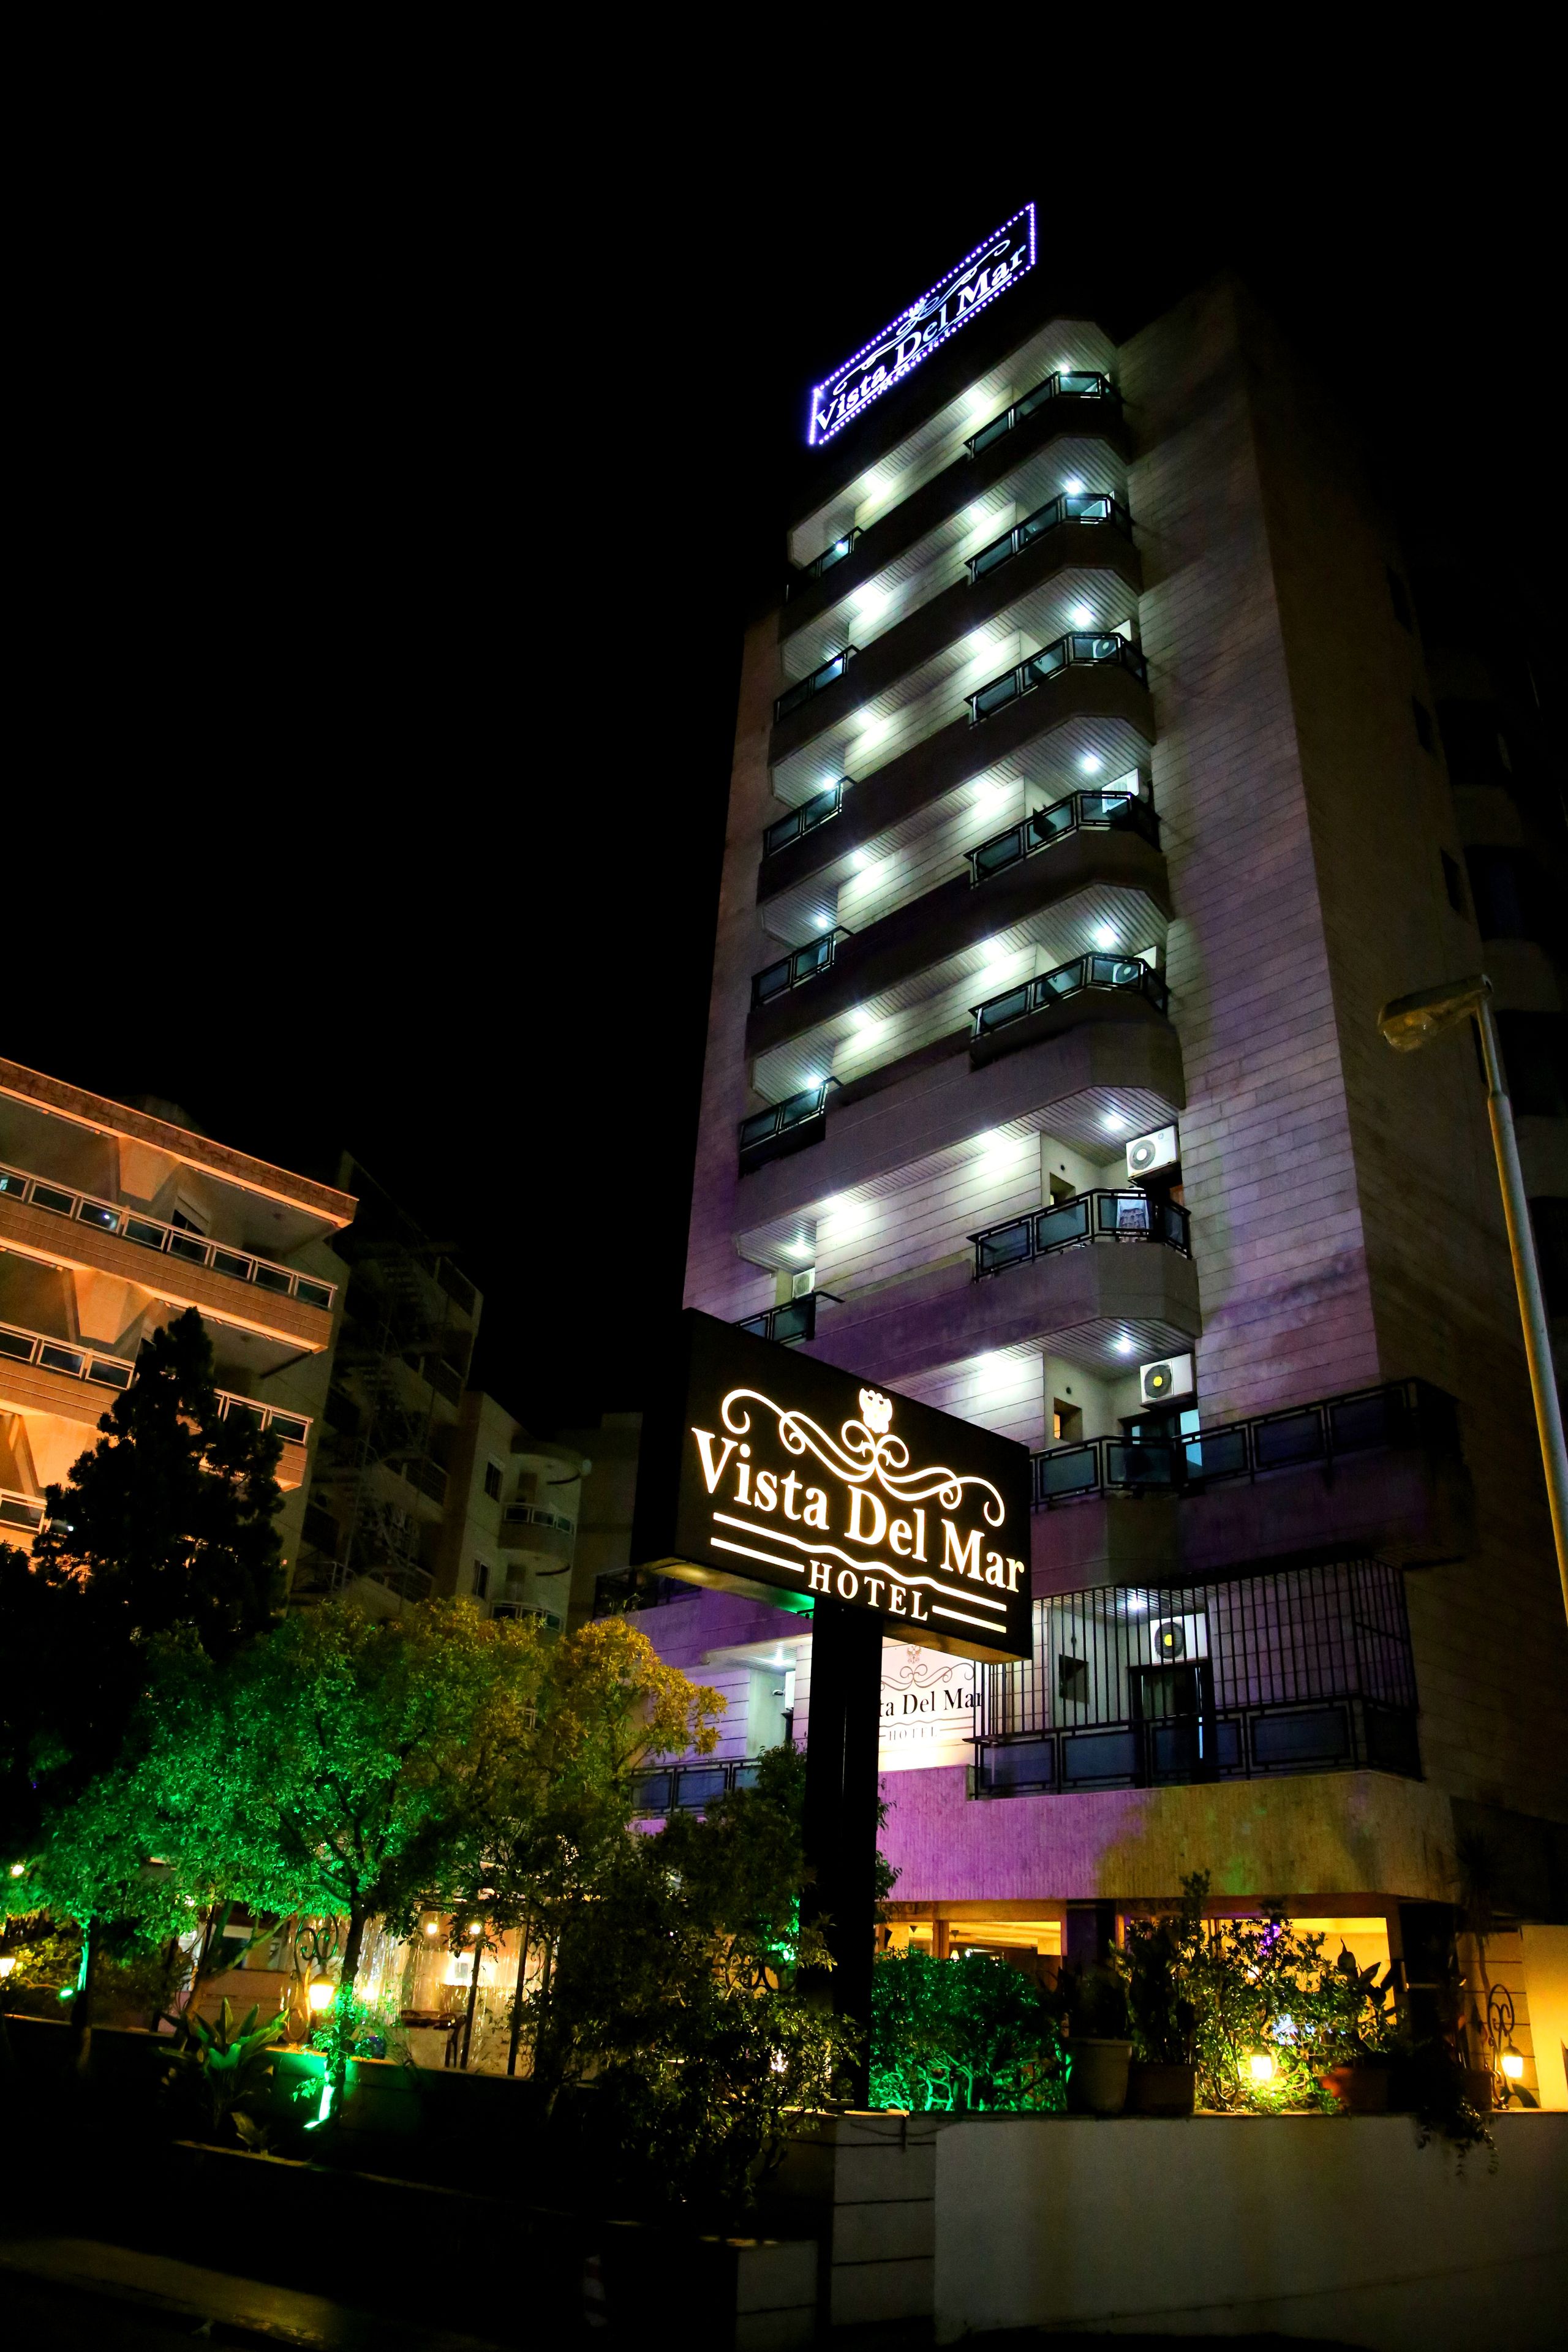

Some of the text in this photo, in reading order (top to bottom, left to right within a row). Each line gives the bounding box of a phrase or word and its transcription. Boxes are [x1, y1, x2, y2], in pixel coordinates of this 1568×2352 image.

[816, 245, 1026, 430] Vista Del Mar
[691, 1427, 1025, 1593] Vista Del Mar
[808, 1559, 929, 1621] HOTEL
[902, 1691, 935, 1715] Del
[943, 1687, 982, 1711] Mar
